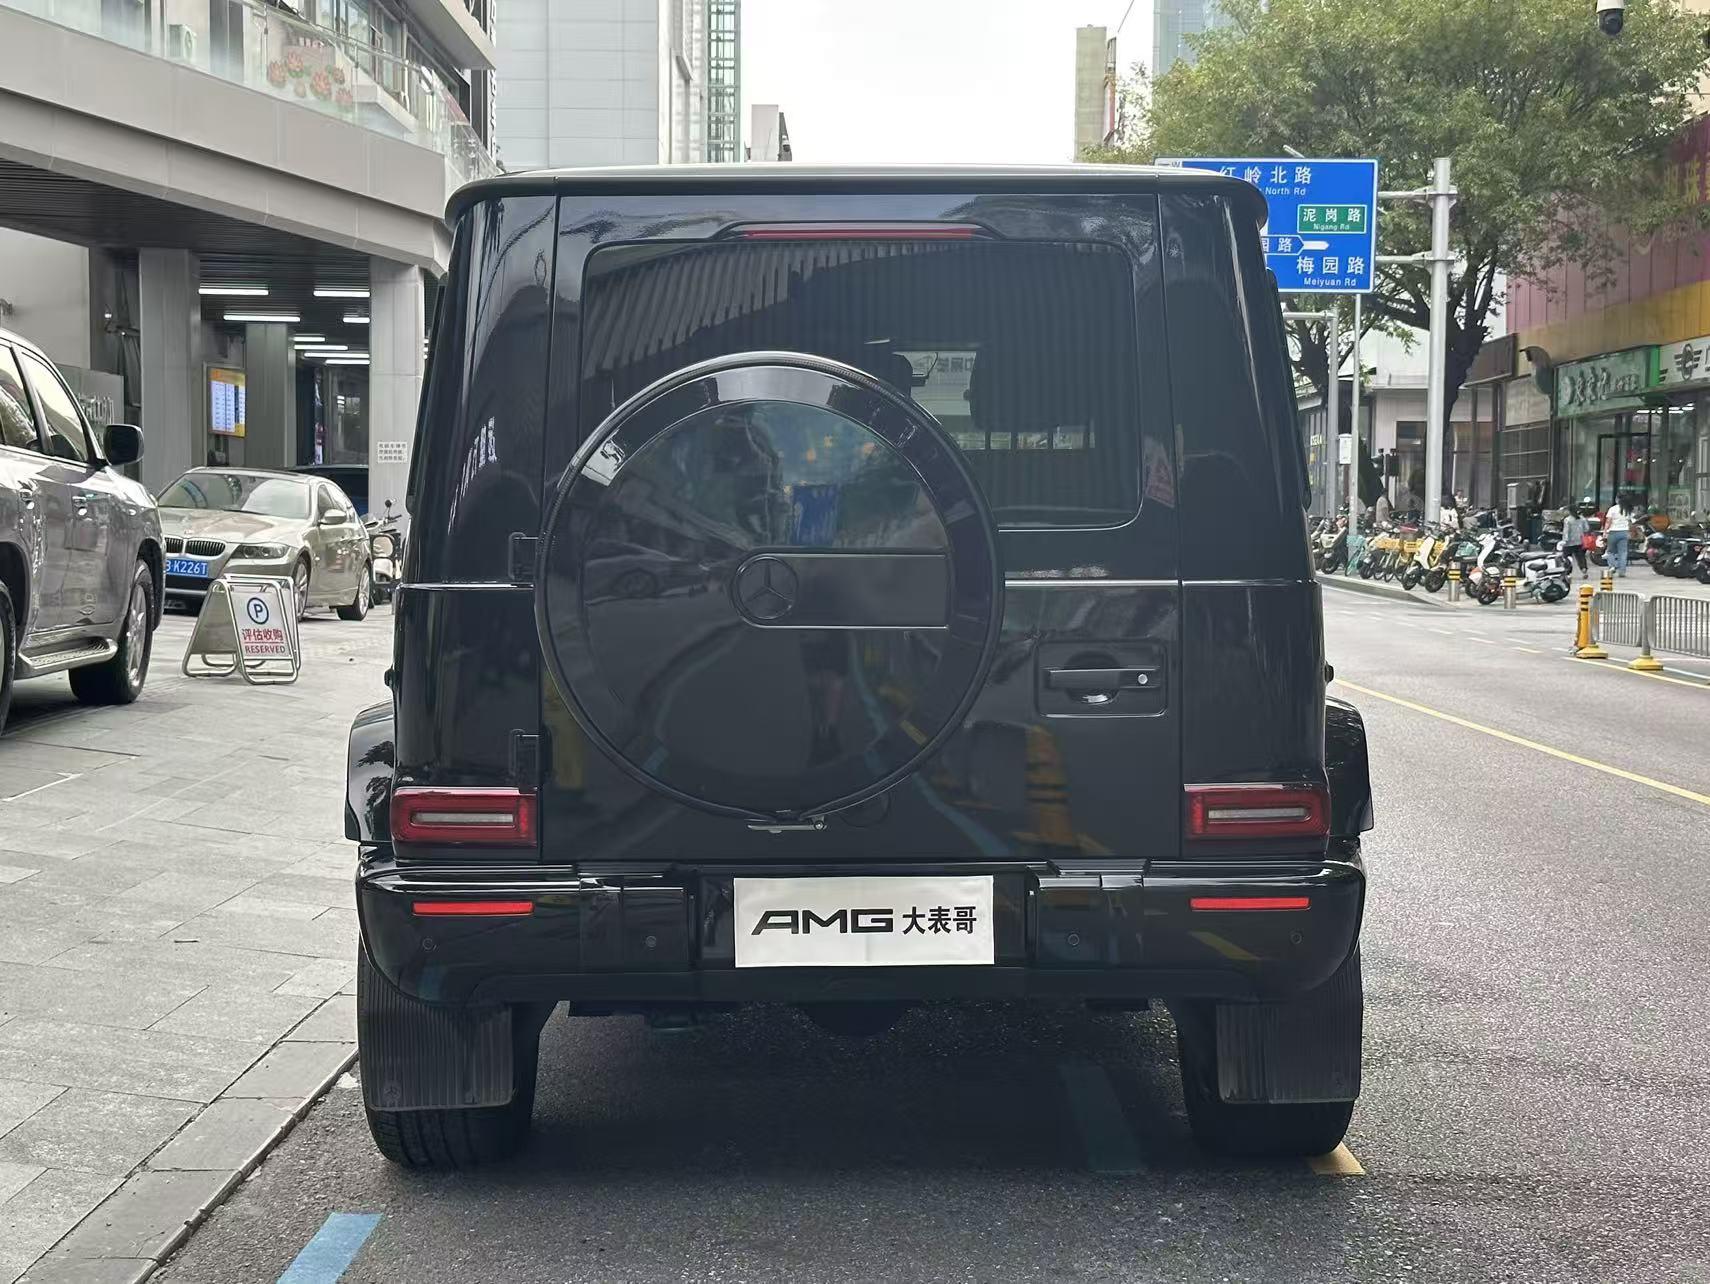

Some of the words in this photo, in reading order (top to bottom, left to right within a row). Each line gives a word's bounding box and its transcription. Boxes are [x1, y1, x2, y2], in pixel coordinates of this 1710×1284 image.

[1265, 187, 1290, 195] North
[1294, 187, 1306, 195] Rd
[1303, 208, 1361, 223] 泥岗路
[1313, 223, 1338, 231] Nigang
[1296, 256, 1364, 275] 梅园路
[1304, 277, 1341, 287] Meiyuan
[1344, 278, 1357, 286] Rd
[242, 628, 284, 641] 评估收购
[244, 645, 286, 654] RESERVED
[751, 909, 894, 935] AMG
[902, 906, 977, 935] 大表哥
